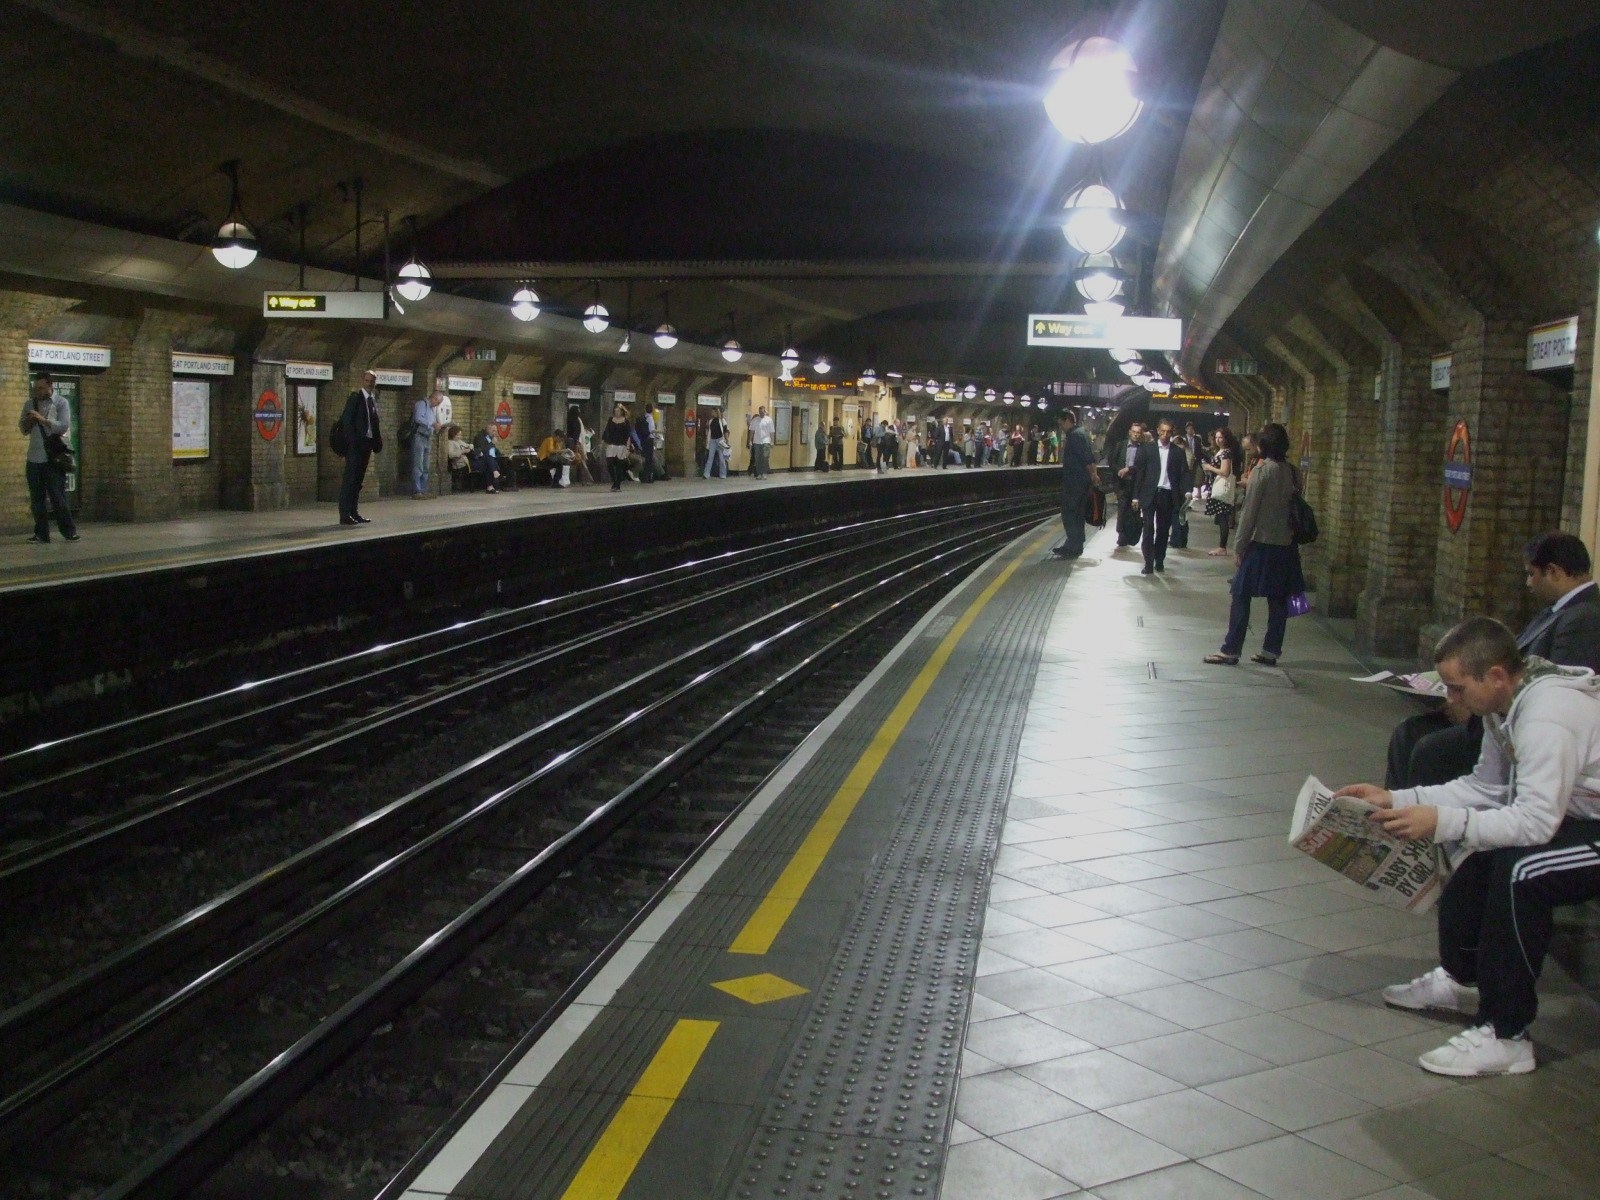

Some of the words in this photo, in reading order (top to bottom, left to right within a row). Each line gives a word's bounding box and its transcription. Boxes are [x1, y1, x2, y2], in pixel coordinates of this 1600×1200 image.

[279, 297, 298, 309] Way
[1048, 322, 1072, 336] Way
[45, 350, 81, 361] PORTLAND
[83, 352, 105, 362] STREET
[1532, 341, 1552, 360] GREAT
[184, 361, 211, 370] PORTLAND
[212, 363, 230, 371] STREET
[1378, 856, 1412, 887] BABY
[1401, 837, 1435, 861] SHO
[1395, 877, 1418, 897] BY
[1407, 861, 1434, 884] GIRL
